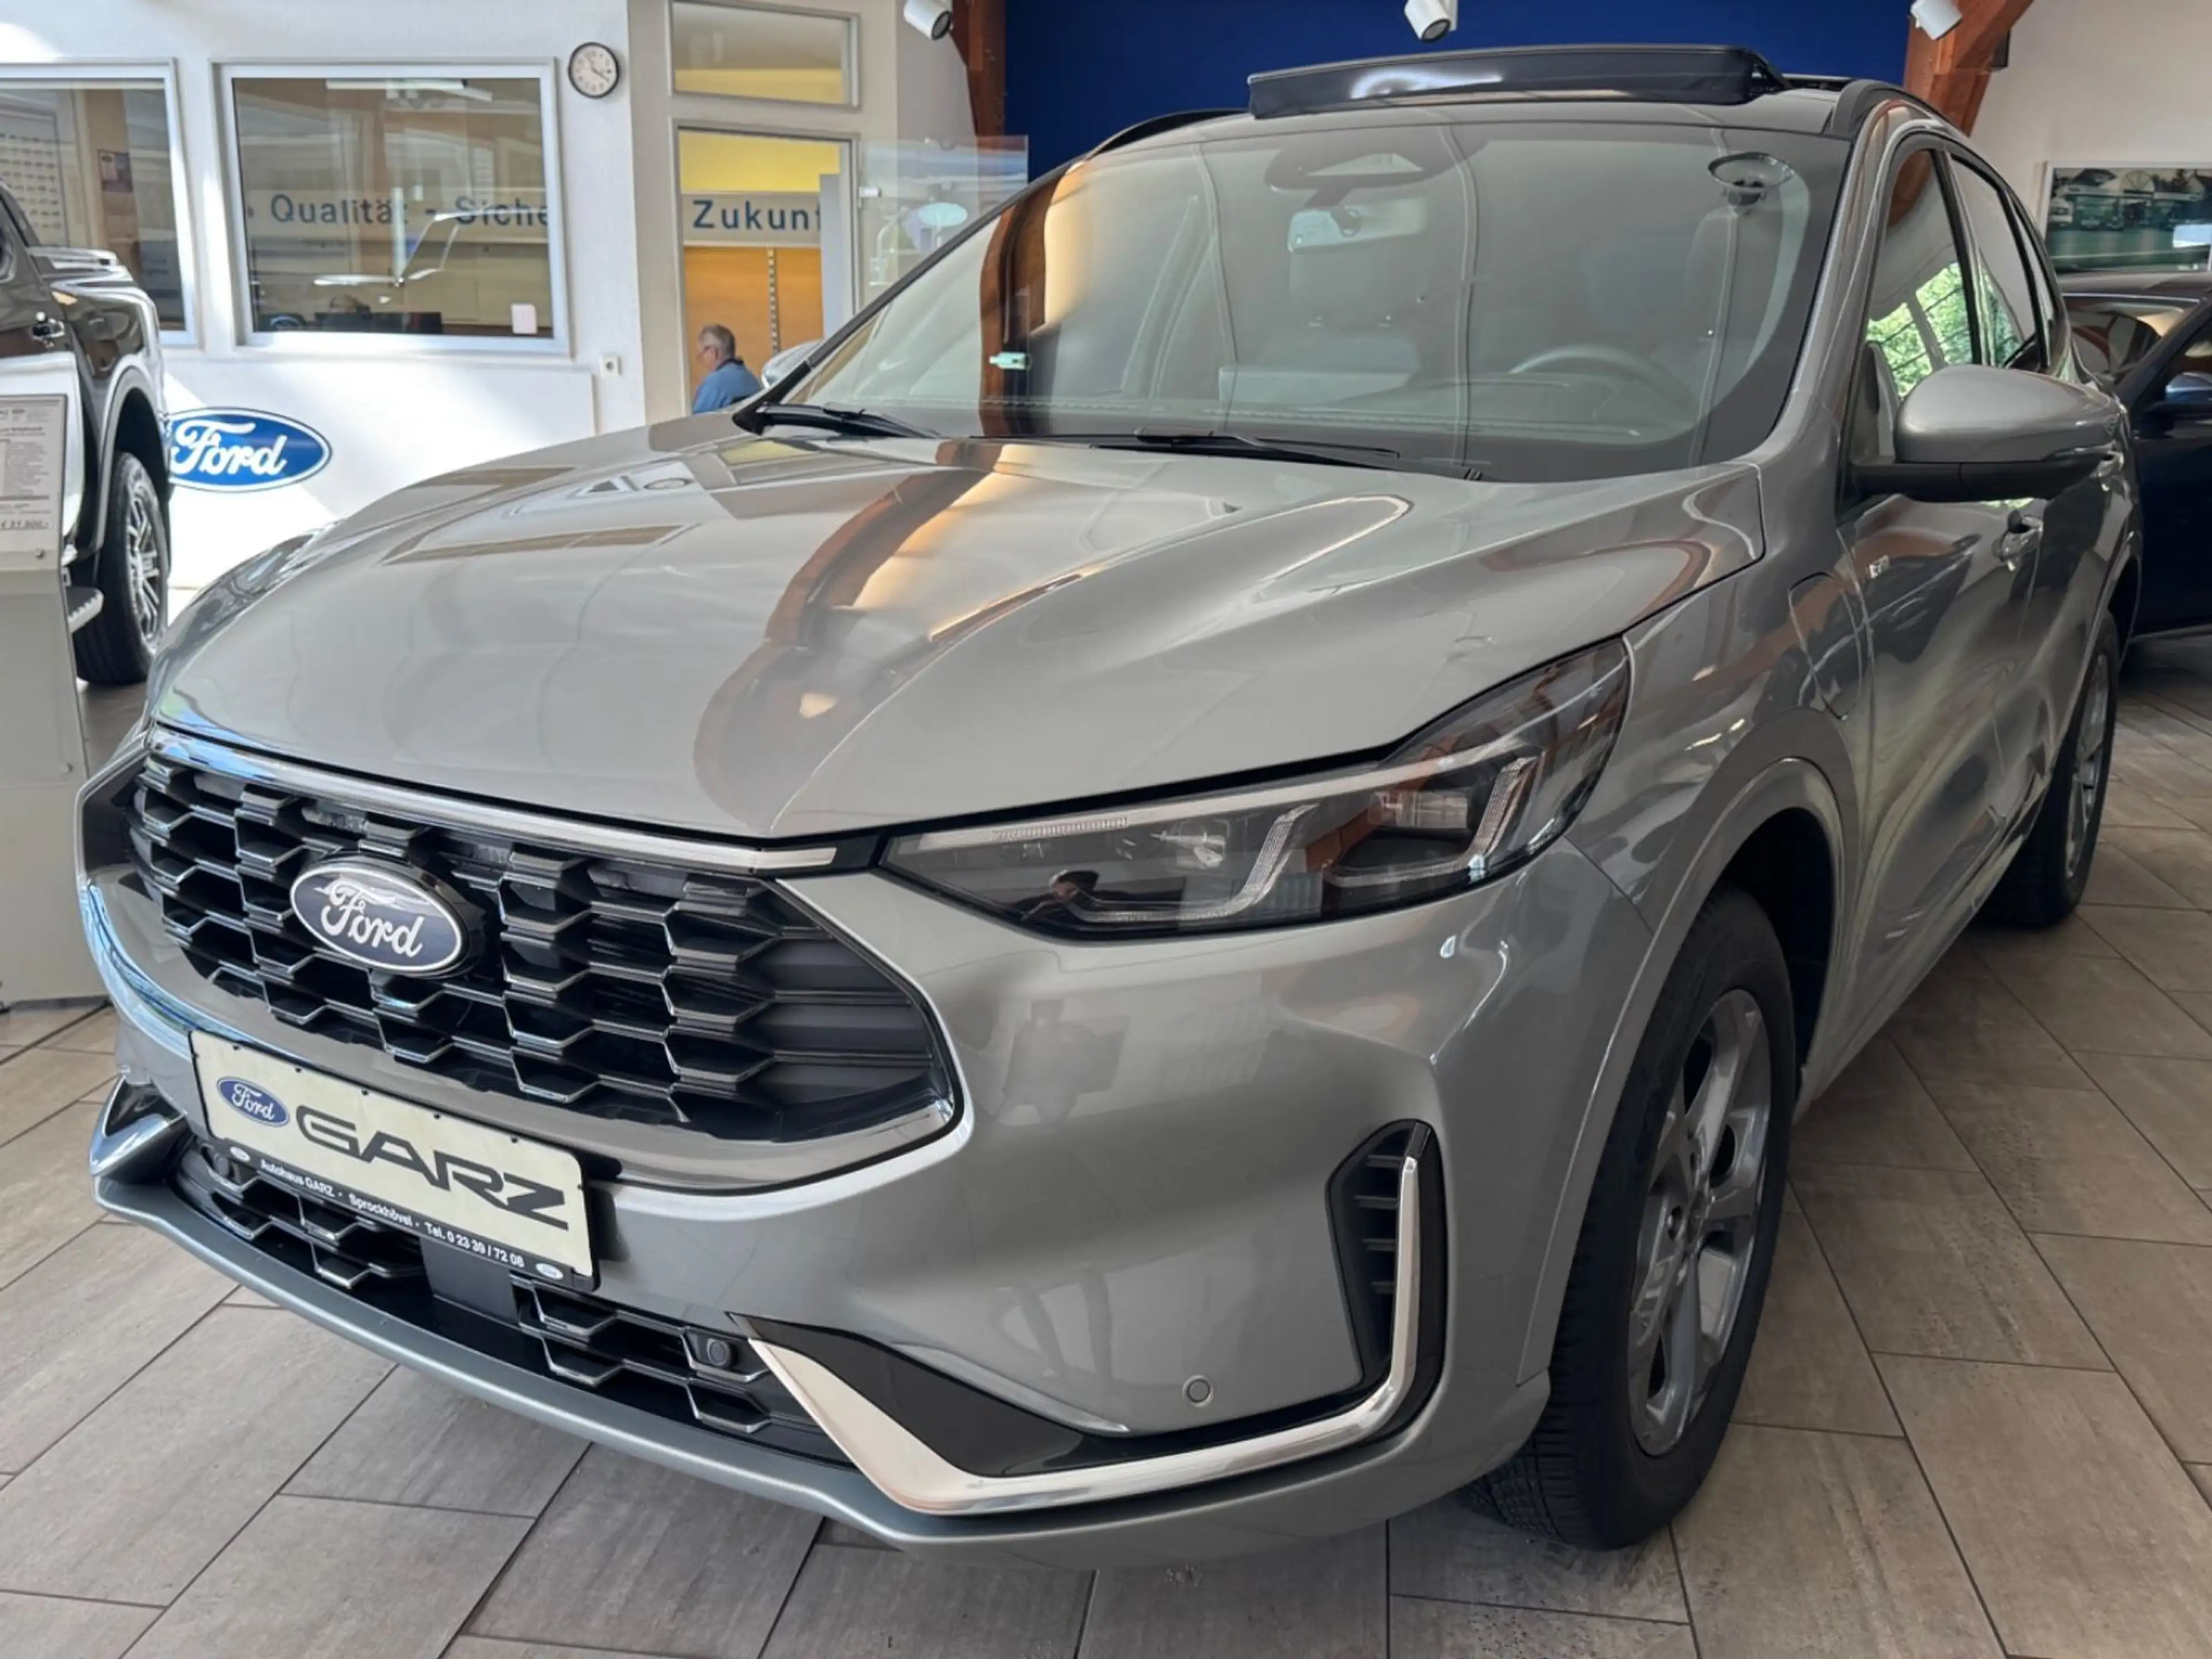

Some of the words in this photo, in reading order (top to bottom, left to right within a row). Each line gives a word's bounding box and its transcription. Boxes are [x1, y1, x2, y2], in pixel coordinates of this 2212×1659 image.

[171, 419, 288, 476] Ford
[318, 876, 425, 957] Ford
[232, 1083, 275, 1120] Ford
[296, 1104, 569, 1232] GARZ
[305, 1176, 335, 1198] GARZ
[424, 1221, 446, 1240] Tel.
[446, 1230, 455, 1243] 0
[456, 1233, 471, 1249] 23
[493, 1247, 508, 1263] 72
